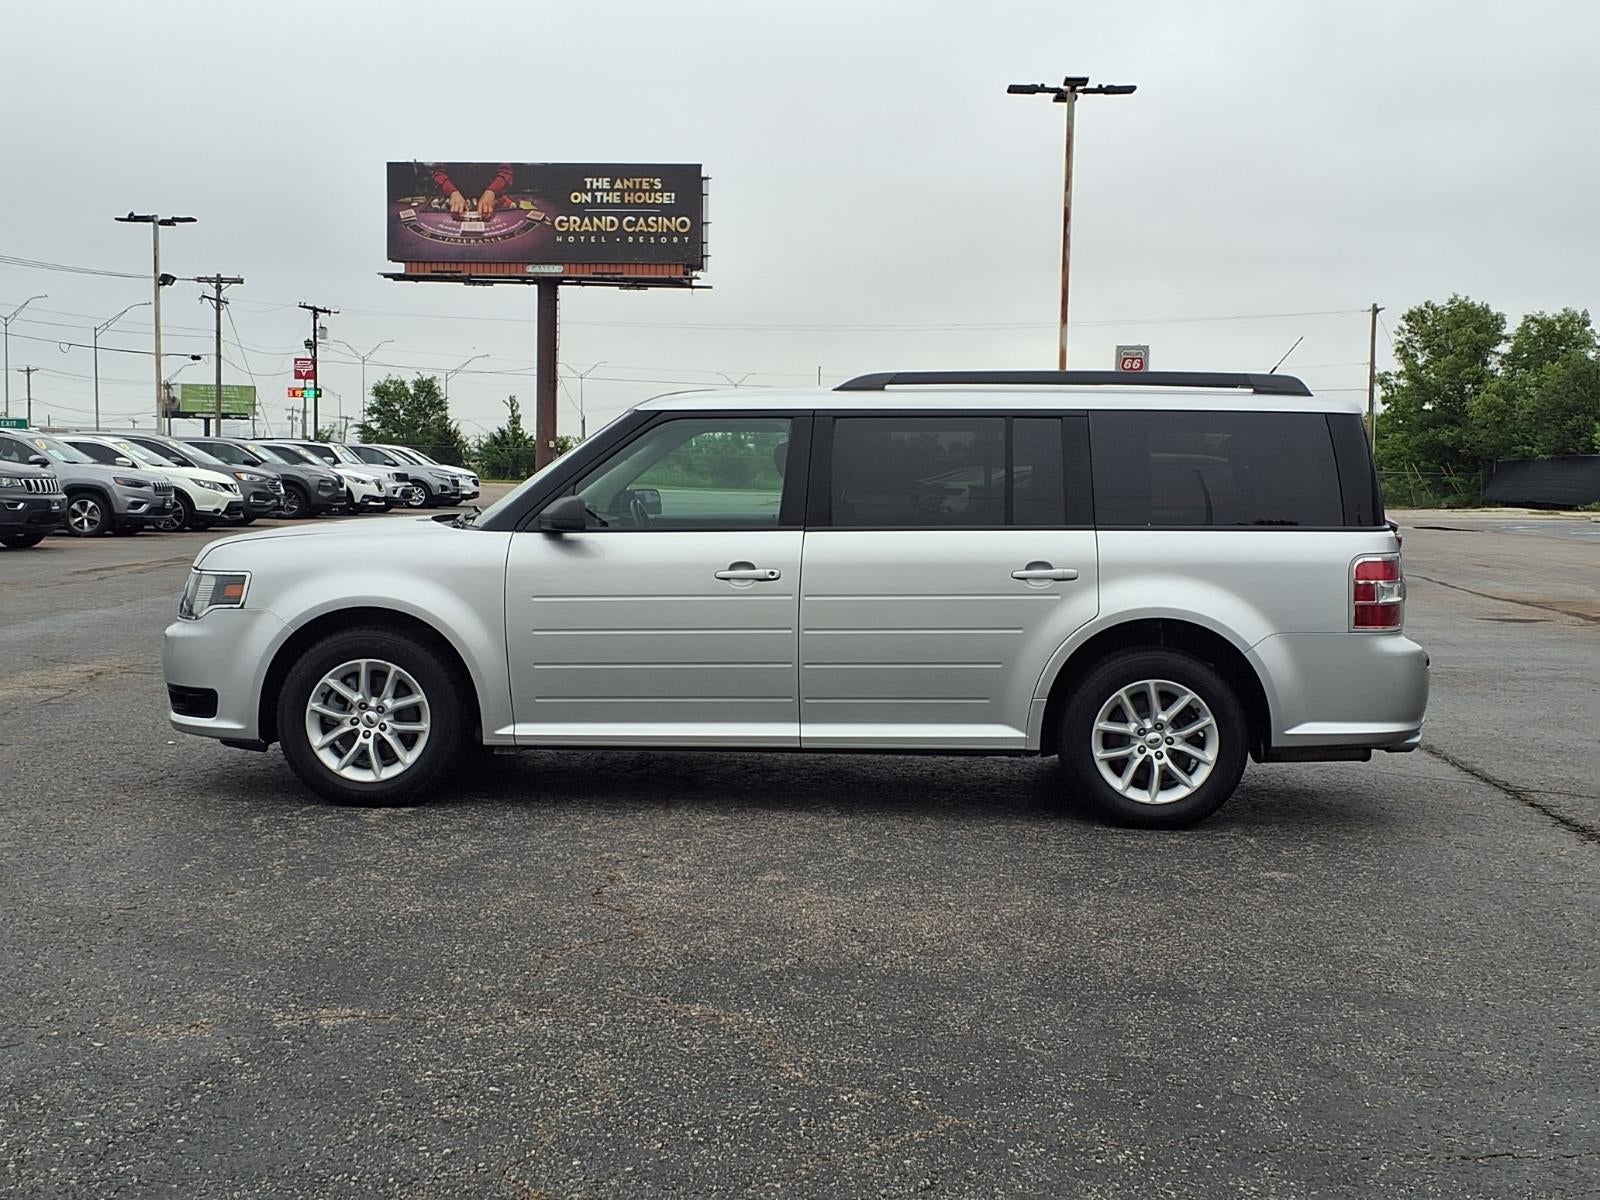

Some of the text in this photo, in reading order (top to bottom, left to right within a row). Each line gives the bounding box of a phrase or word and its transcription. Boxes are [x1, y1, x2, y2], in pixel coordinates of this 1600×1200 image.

[584, 178, 662, 190] THE ANTE'S
[570, 192, 676, 204] ON THE HOUSE!
[554, 215, 692, 233] GRAND CASINO
[556, 235, 690, 244] HOTEL RESORT
[1123, 358, 1141, 369] 66
